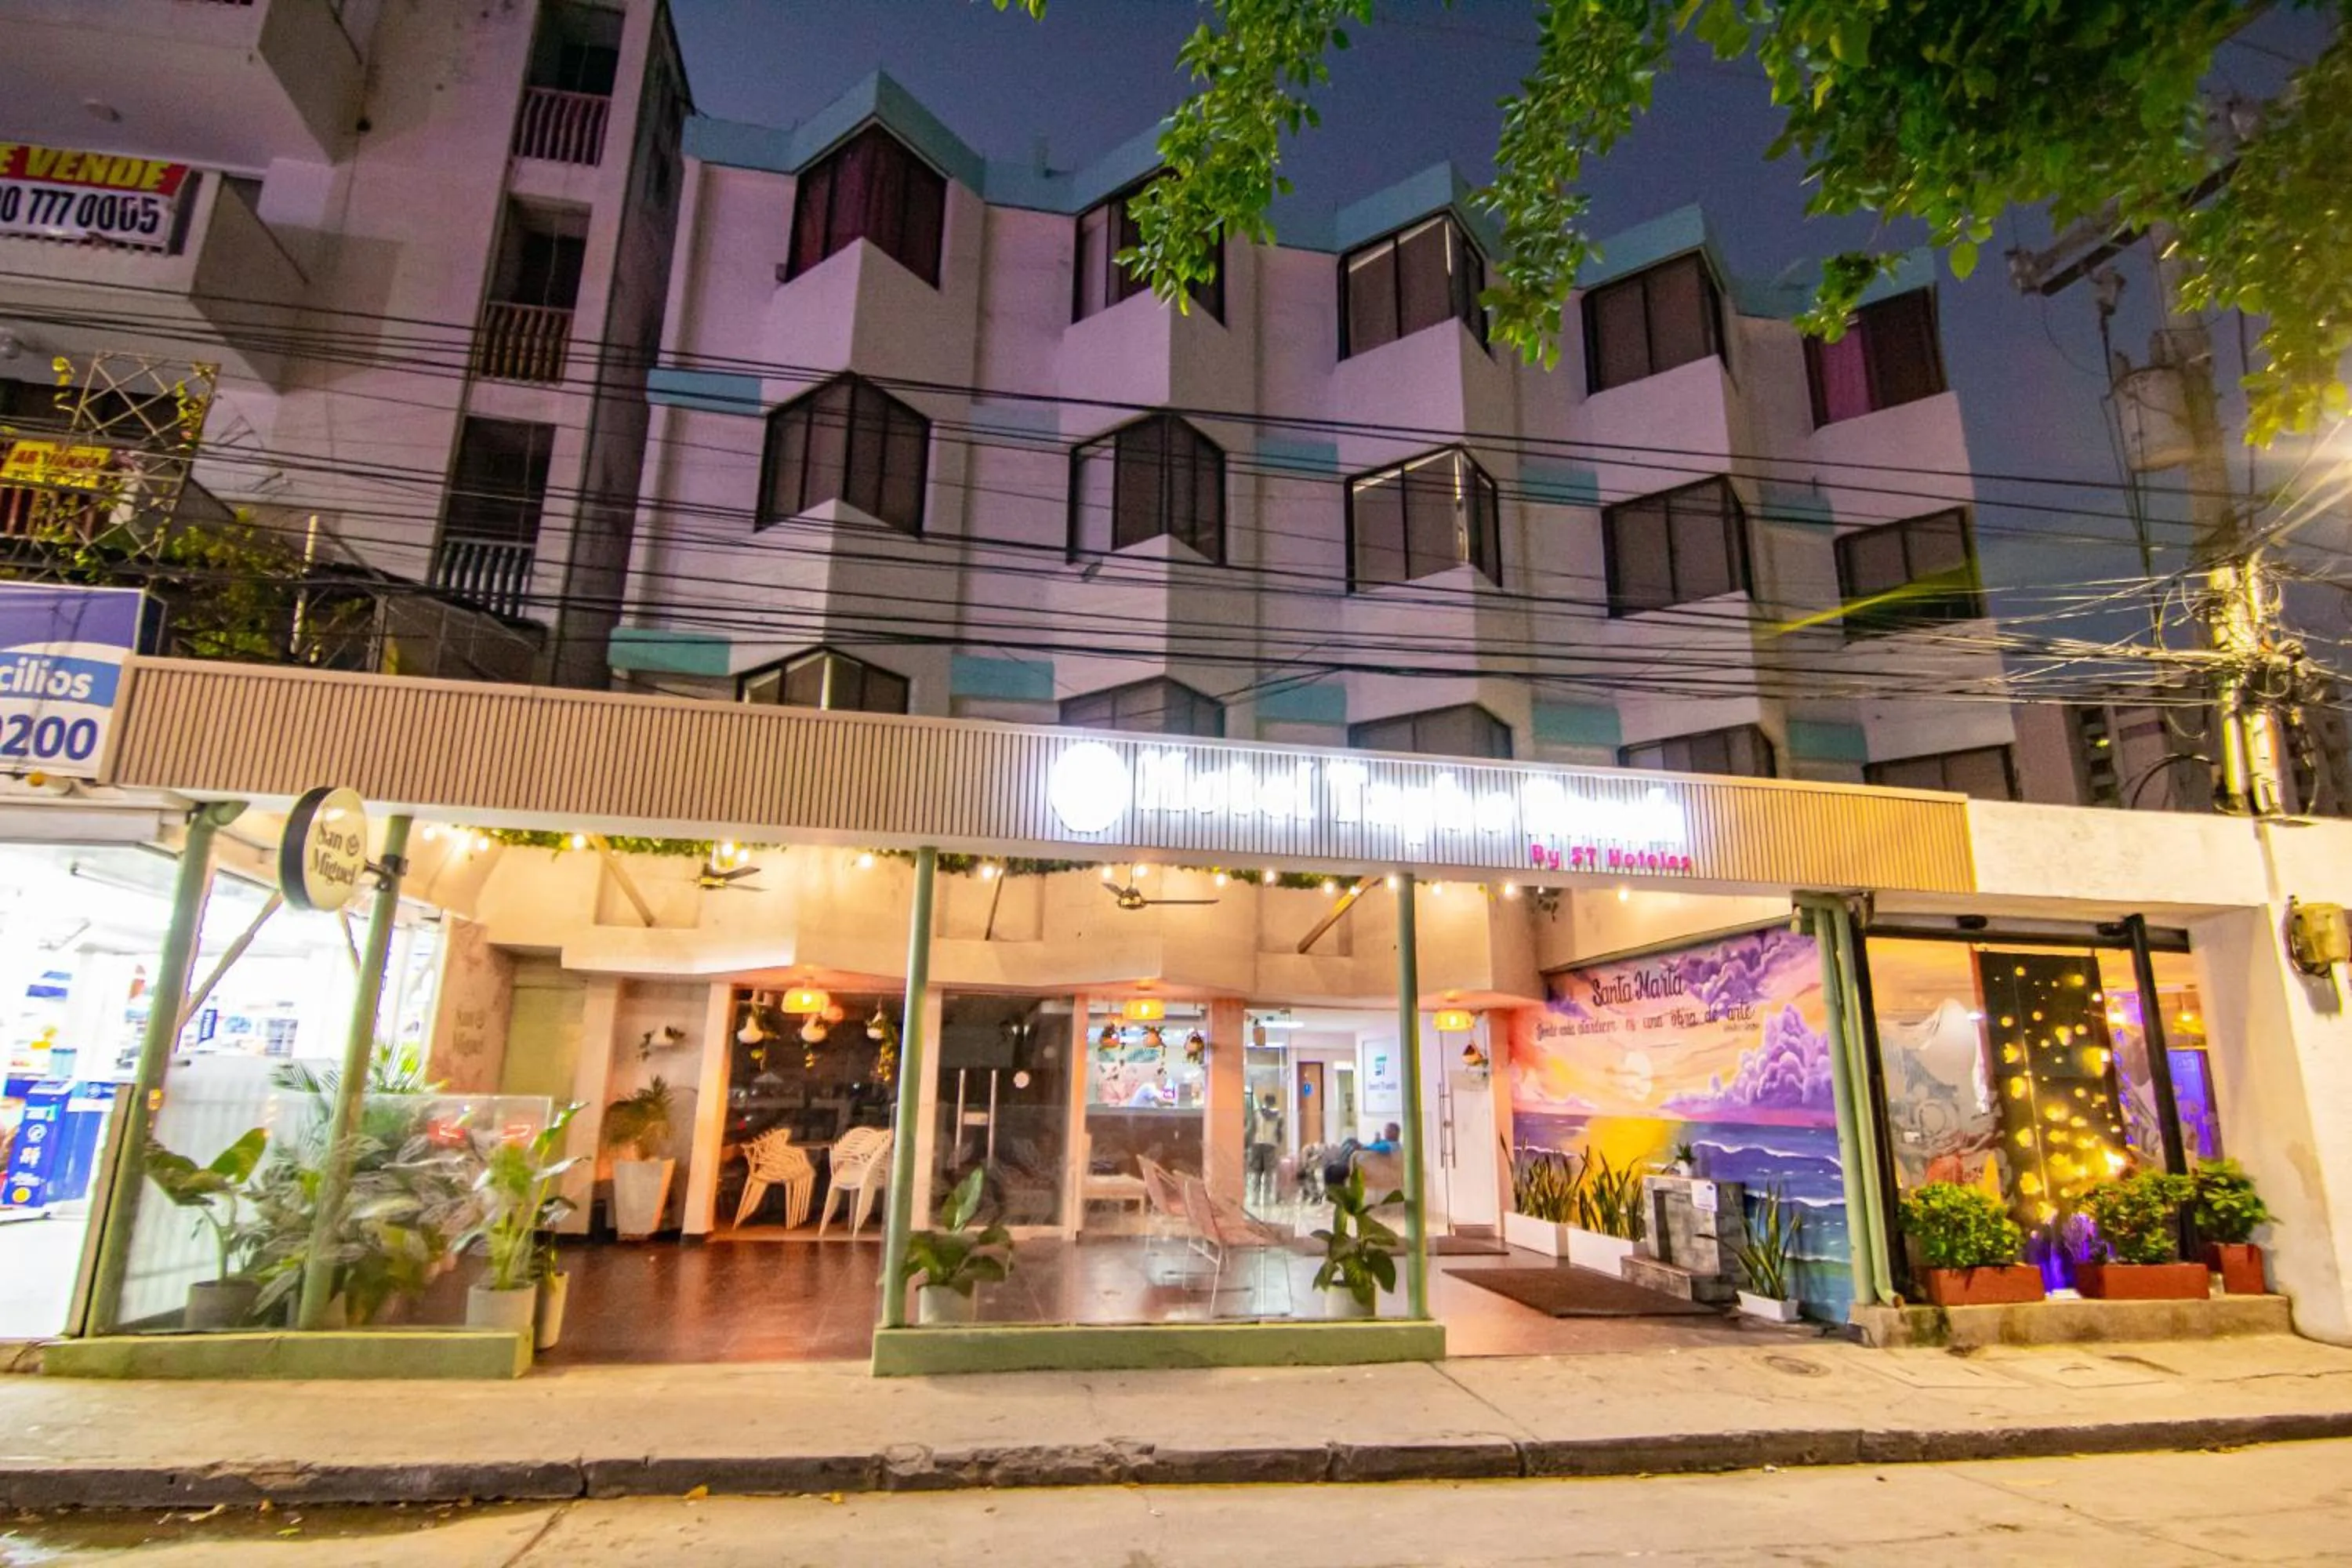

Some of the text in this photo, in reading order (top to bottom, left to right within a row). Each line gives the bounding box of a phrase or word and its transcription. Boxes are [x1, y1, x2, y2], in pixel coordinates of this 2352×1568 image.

[26, 145, 170, 189] VENDE
[0, 186, 22, 222] 0
[27, 188, 76, 226] 777
[0, 657, 93, 699] cilios
[0, 713, 98, 762] 200
[316, 821, 343, 851] San
[309, 848, 359, 886] Miguel
[1530, 843, 1560, 871] By
[1607, 847, 1693, 871] Hoteles
[1592, 965, 1684, 1007] Santa Marta
